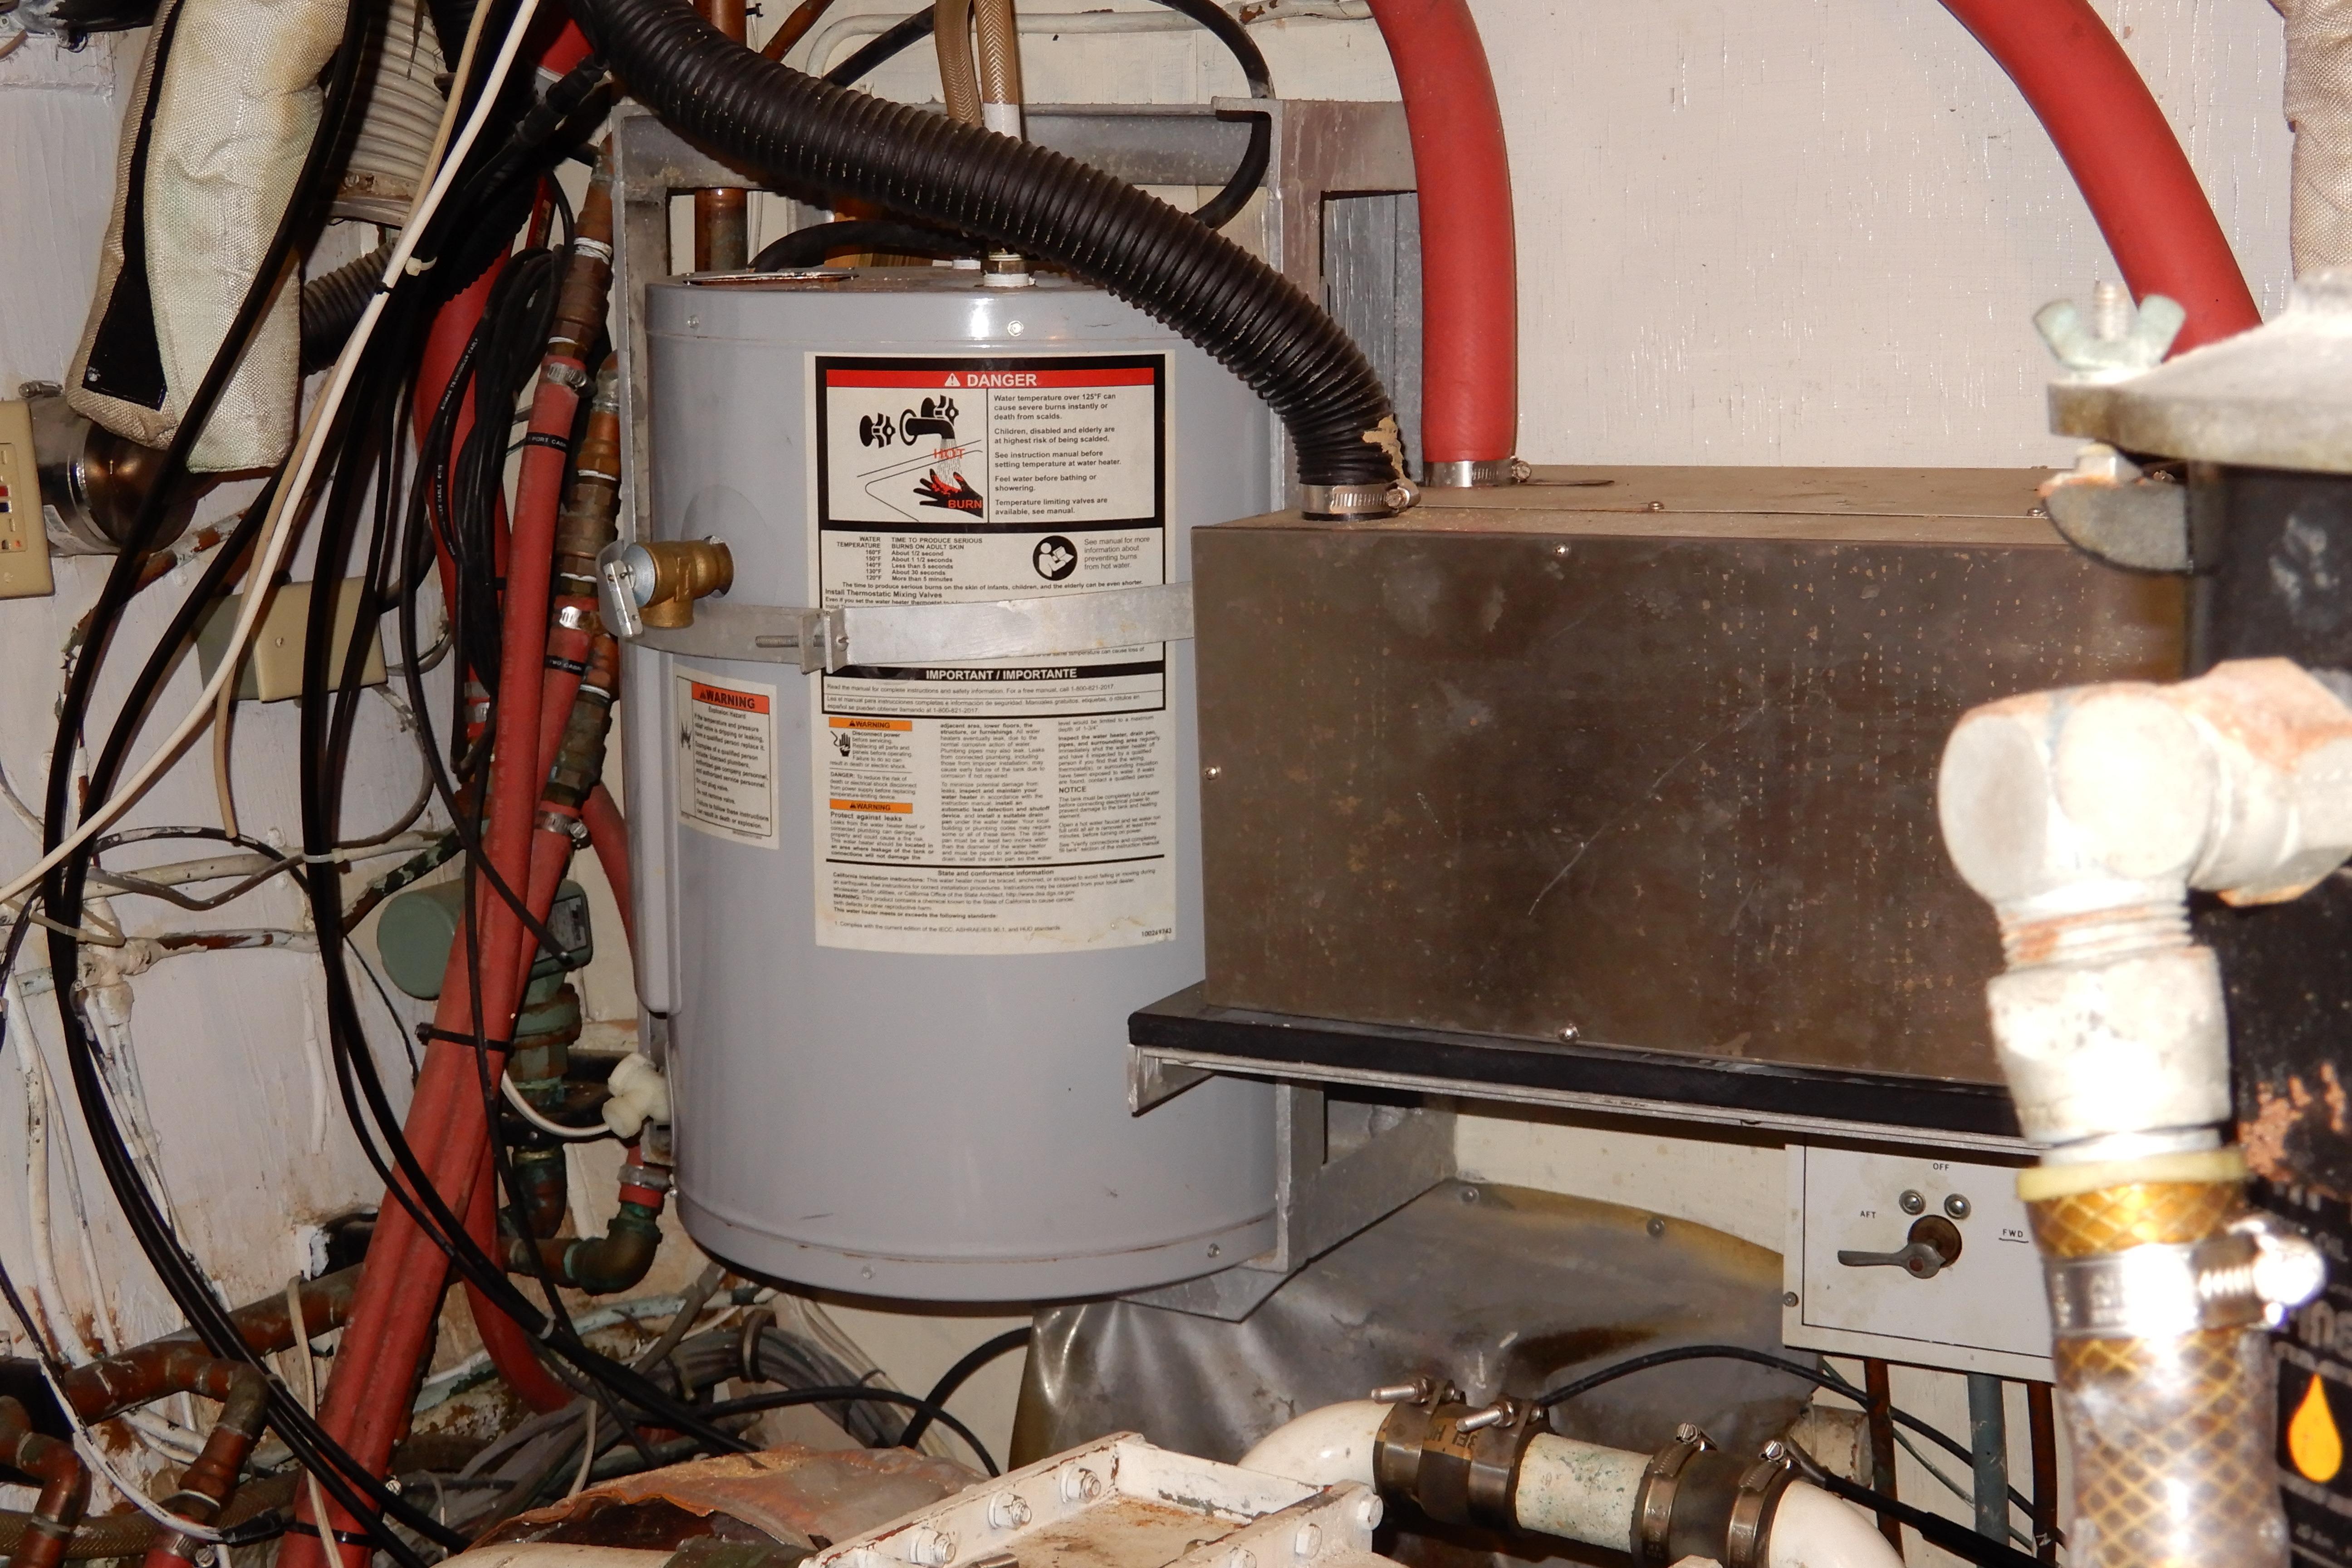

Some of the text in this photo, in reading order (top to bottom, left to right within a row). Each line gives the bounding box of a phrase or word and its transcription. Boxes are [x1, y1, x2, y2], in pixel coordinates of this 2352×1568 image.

[967, 373, 1038, 387] DANGER
[934, 448, 965, 460] HOT
[948, 500, 983, 510] BURN
[926, 668, 1078, 681] IMPORTANT / IMPORTANTE
[706, 690, 755, 709] WARNING
[1860, 1210, 1876, 1219] AFT
[2002, 1229, 2024, 1238] FWD
